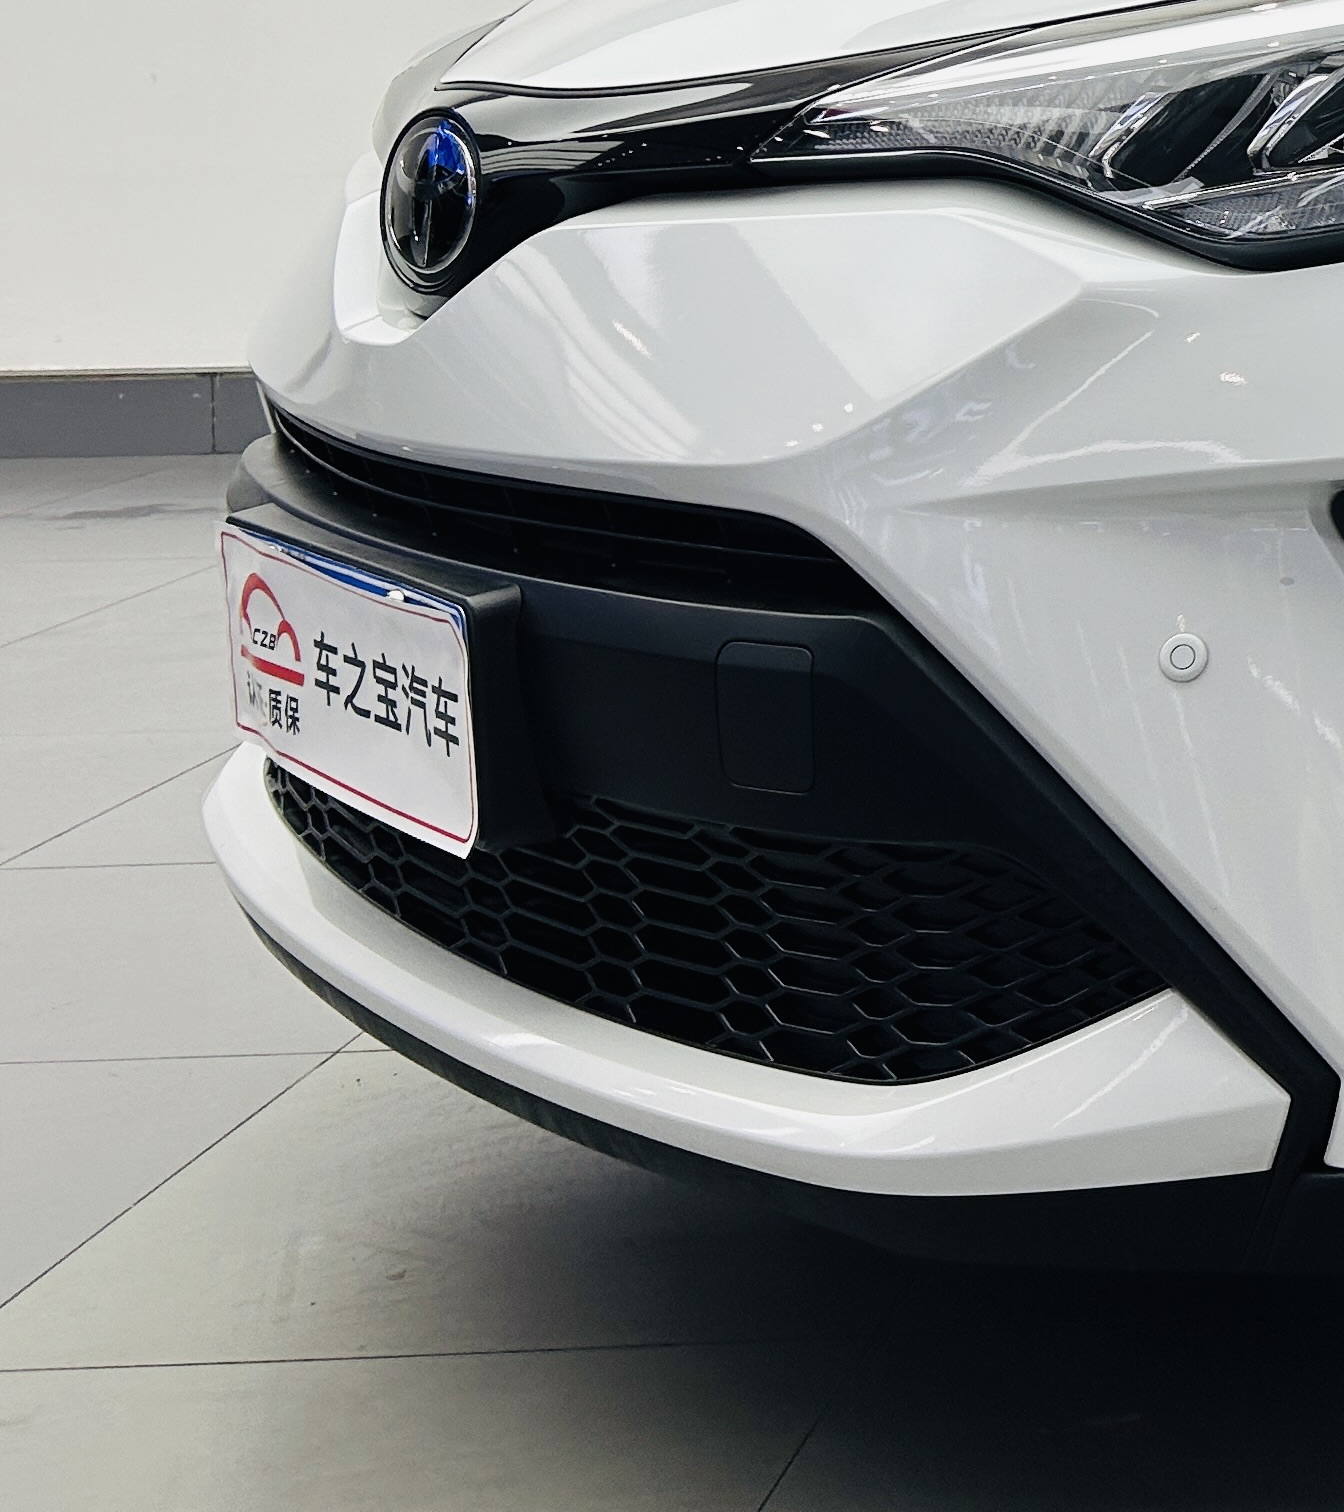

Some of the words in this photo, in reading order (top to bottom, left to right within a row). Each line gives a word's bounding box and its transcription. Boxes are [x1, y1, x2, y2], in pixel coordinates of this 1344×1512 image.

[251, 628, 277, 651] CZB
[313, 631, 460, 757] 车之宝汽车
